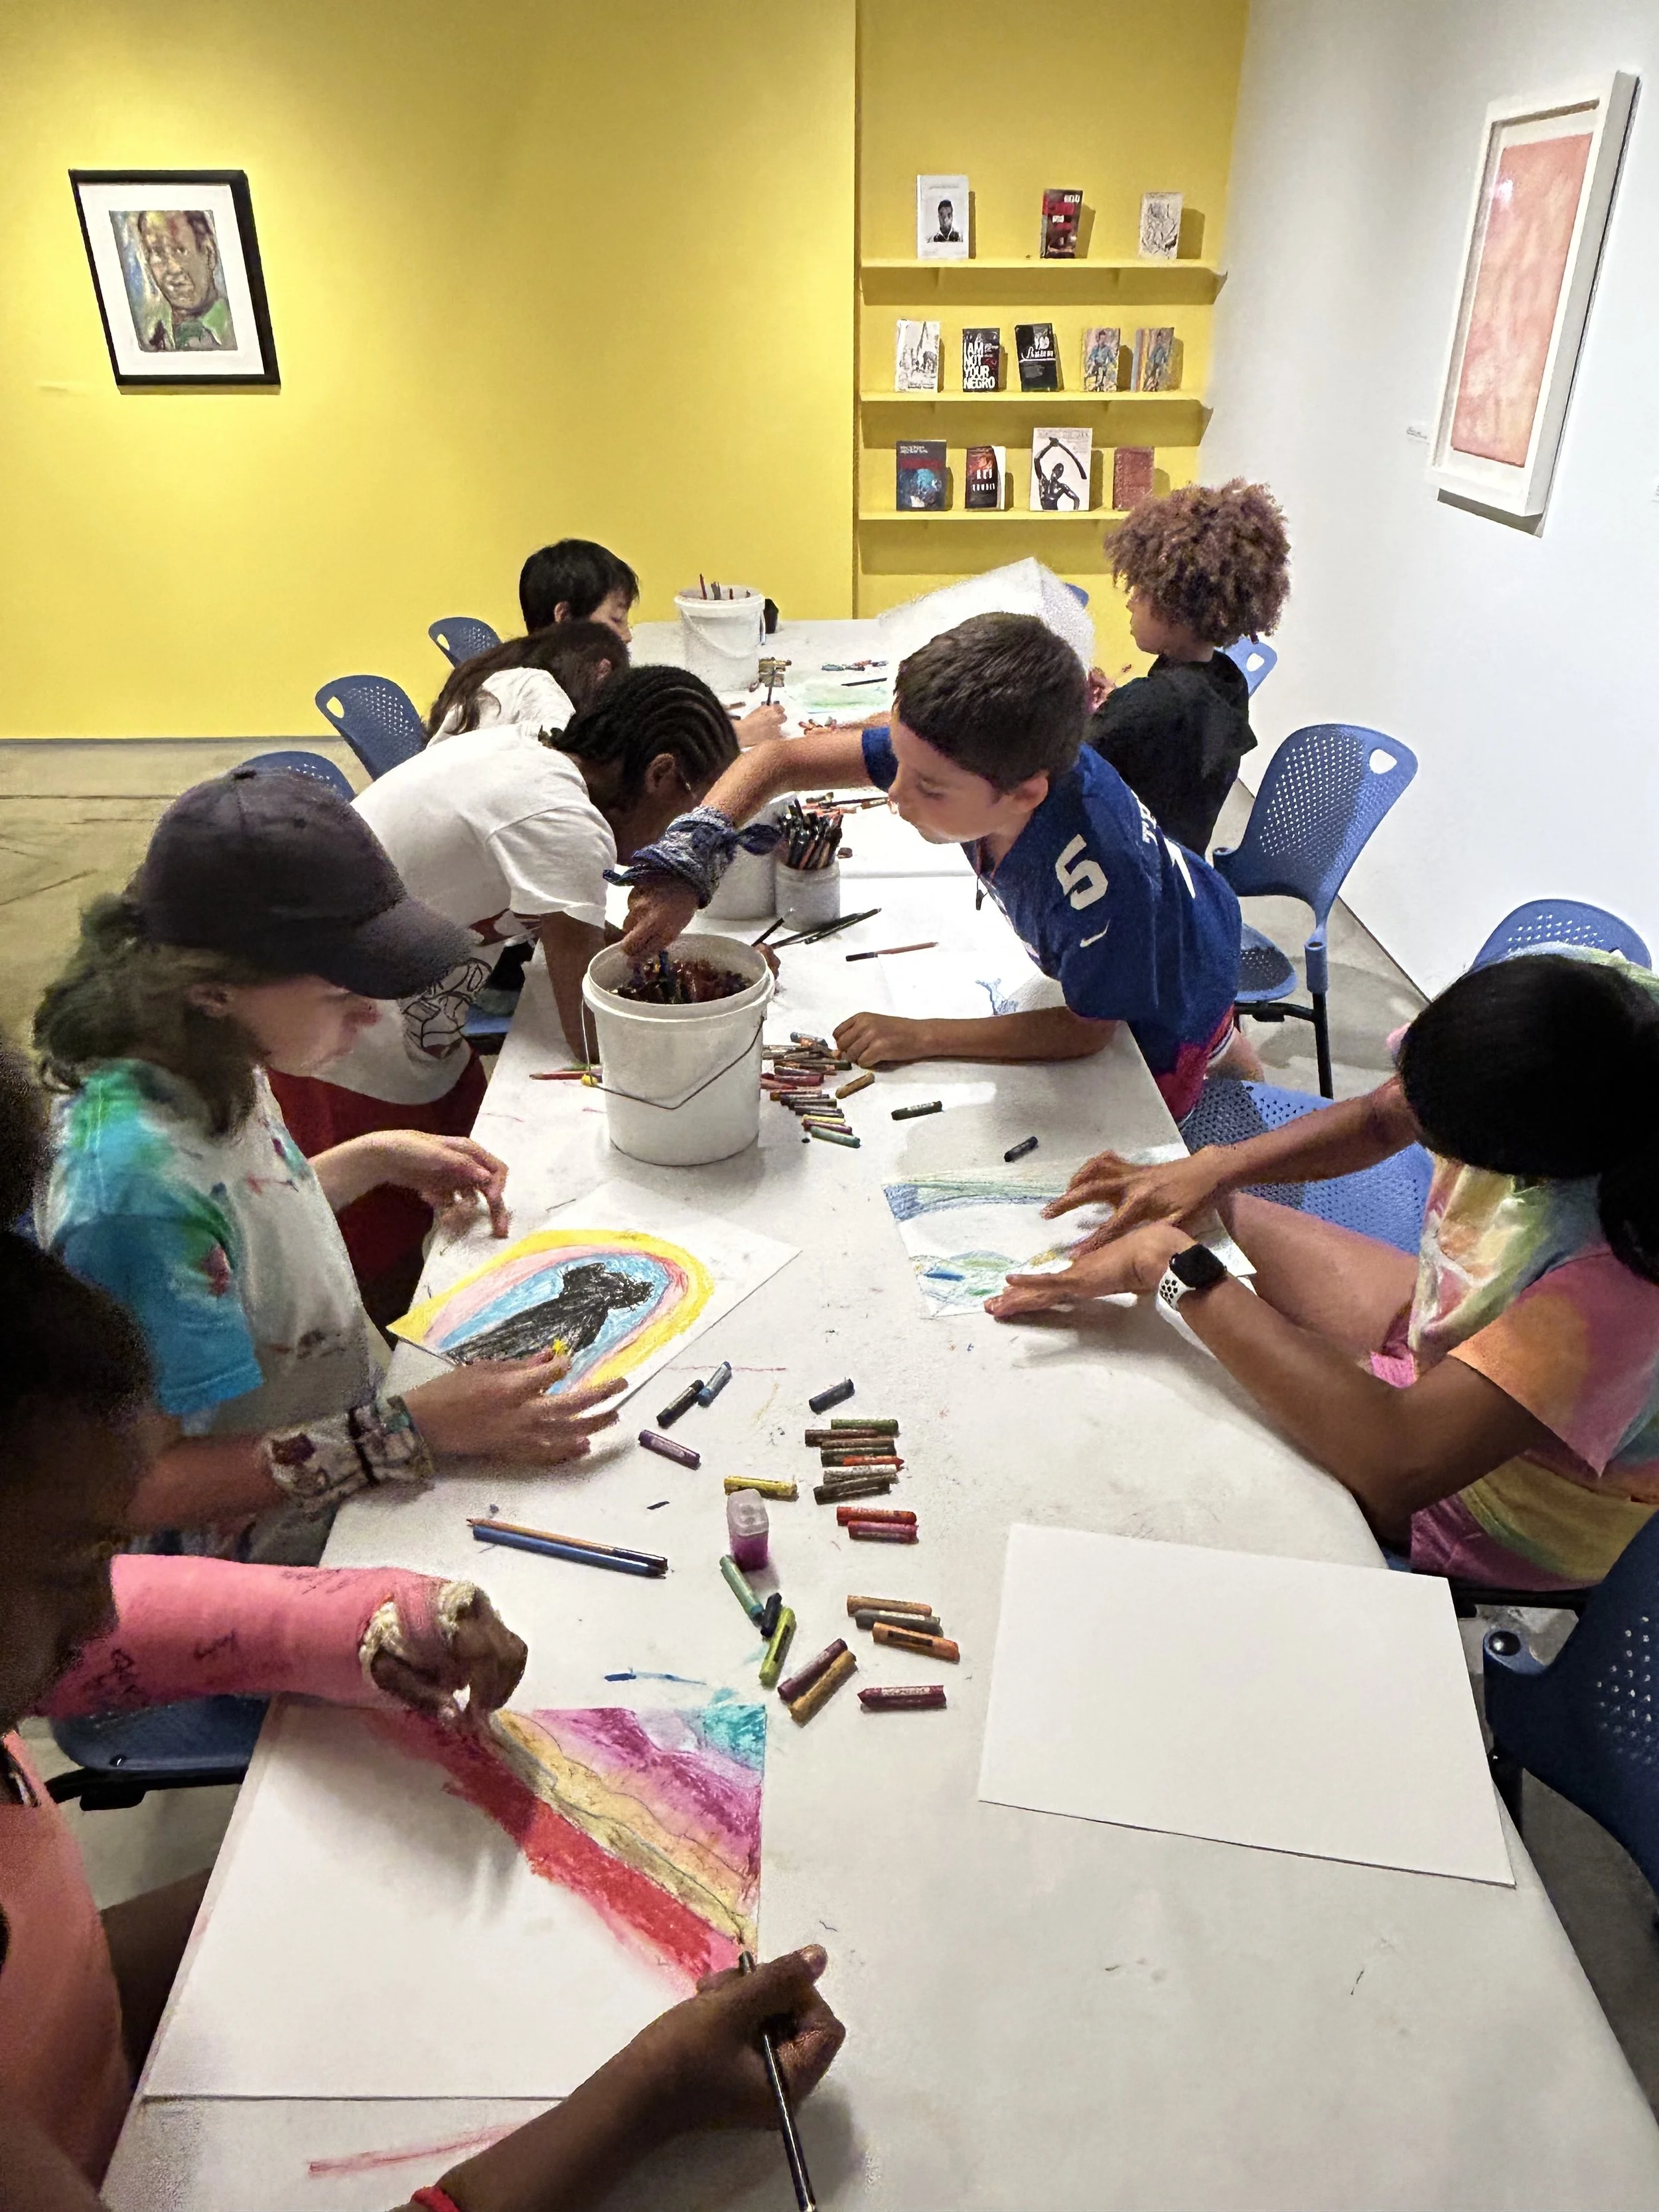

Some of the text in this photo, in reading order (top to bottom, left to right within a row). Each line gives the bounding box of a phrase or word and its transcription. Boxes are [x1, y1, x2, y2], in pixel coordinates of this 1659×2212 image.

[968, 340, 983, 357] AM
[964, 354, 981, 371] NOT
[964, 365, 989, 378] YOUR
[963, 376, 995, 389] NEGRO
[1055, 834, 1109, 911] 5
